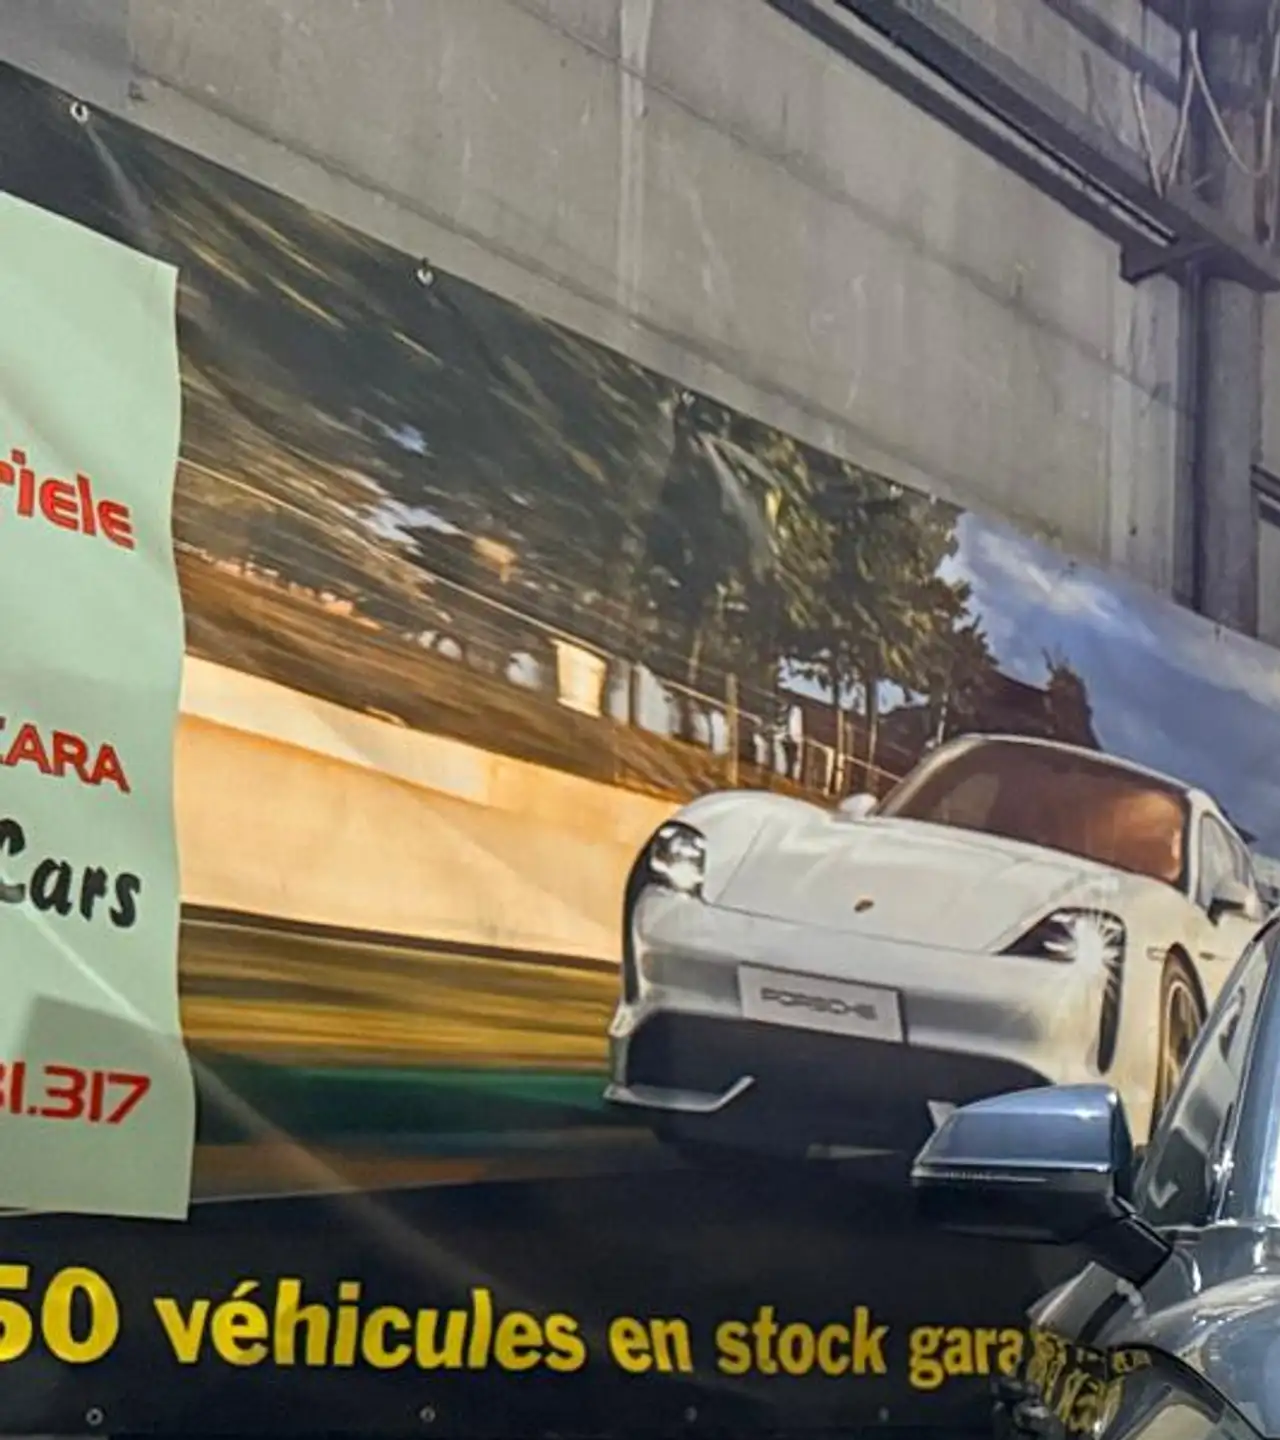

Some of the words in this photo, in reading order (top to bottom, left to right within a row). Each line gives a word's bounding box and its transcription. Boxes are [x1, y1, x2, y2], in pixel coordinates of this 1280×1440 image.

[0, 717, 130, 793] ARA
[0, 1062, 152, 1124] 1.317
[154, 1279, 587, 1372] véhicules
[609, 1314, 693, 1372] en
[715, 1306, 888, 1375] stock
